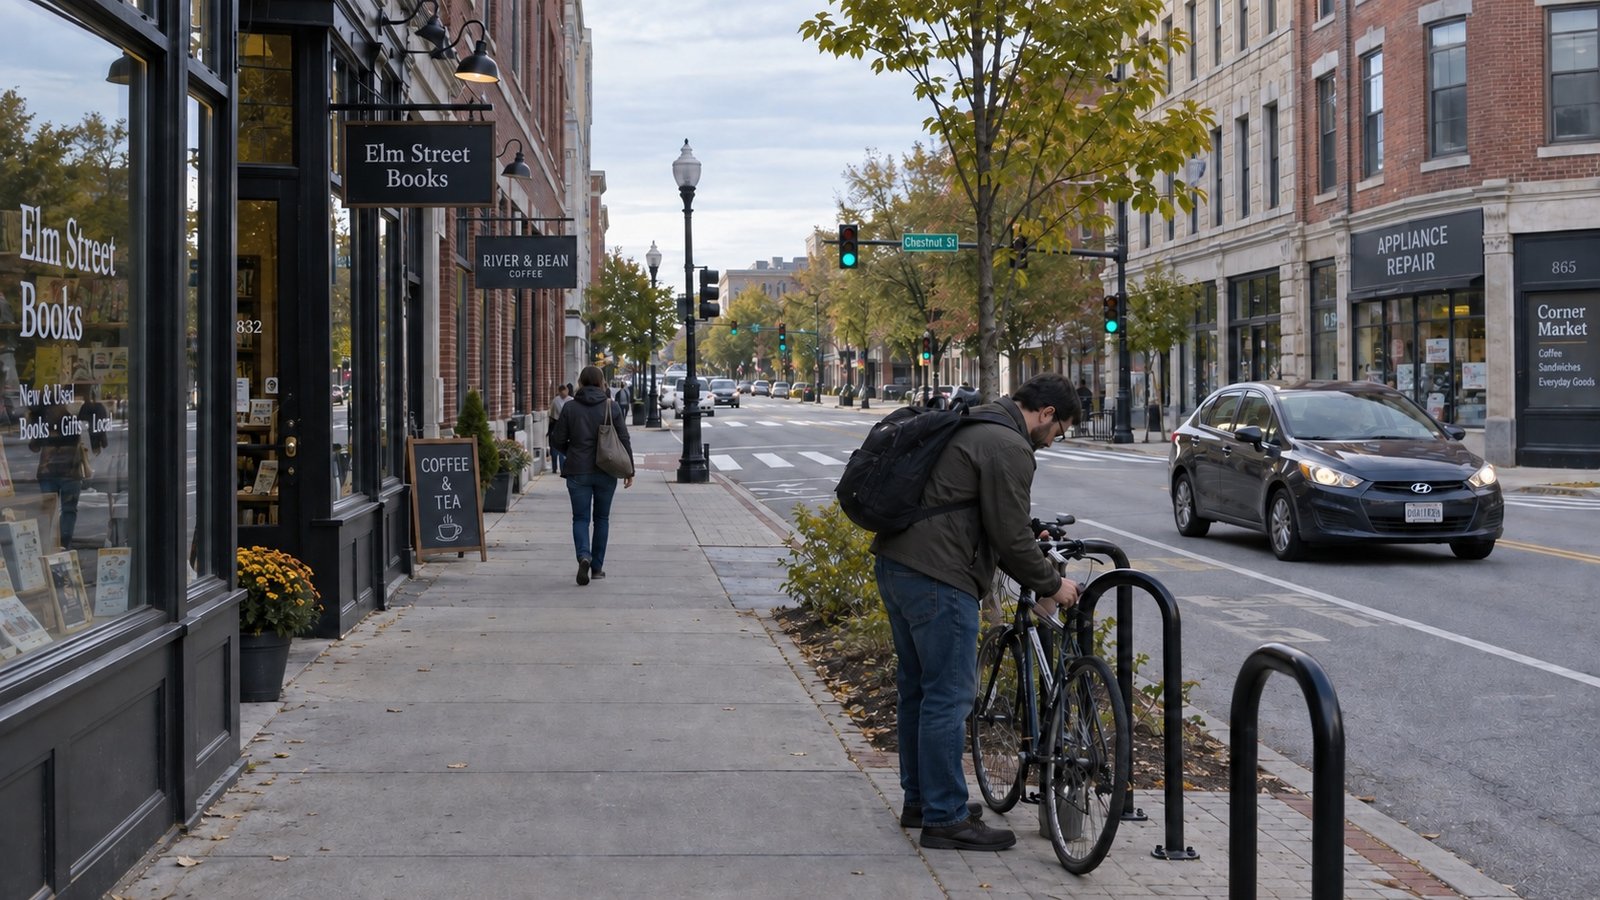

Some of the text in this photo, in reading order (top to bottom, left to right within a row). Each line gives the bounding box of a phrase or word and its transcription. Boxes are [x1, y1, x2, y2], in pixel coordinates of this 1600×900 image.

[364, 143, 471, 163] Elm Street
[386, 168, 449, 188] Books
[19, 203, 117, 277] Elm Street
[904, 236, 955, 247] Chestnut St
[1377, 225, 1448, 255] APPLIANCE
[483, 254, 569, 267] RIVER & BEAN
[1387, 252, 1435, 276] REPAIR
[1552, 260, 1577, 274] 865
[509, 269, 543, 278] COFFEE
[19, 280, 83, 341] Books
[1537, 304, 1586, 319] Corner
[236, 320, 262, 334] 832
[1537, 321, 1588, 336] Market
[1538, 349, 1563, 358] Coffee
[1538, 363, 1581, 372] Sandwiches
[1538, 377, 1595, 388] Everyday Goods
[19, 383, 75, 407] New & Used
[19, 416, 49, 440] Books
[61, 414, 82, 436] Gifts
[92, 412, 113, 433] Local
[421, 457, 469, 472] COFFEE
[441, 476, 451, 491] &
[434, 494, 462, 510] TEA
